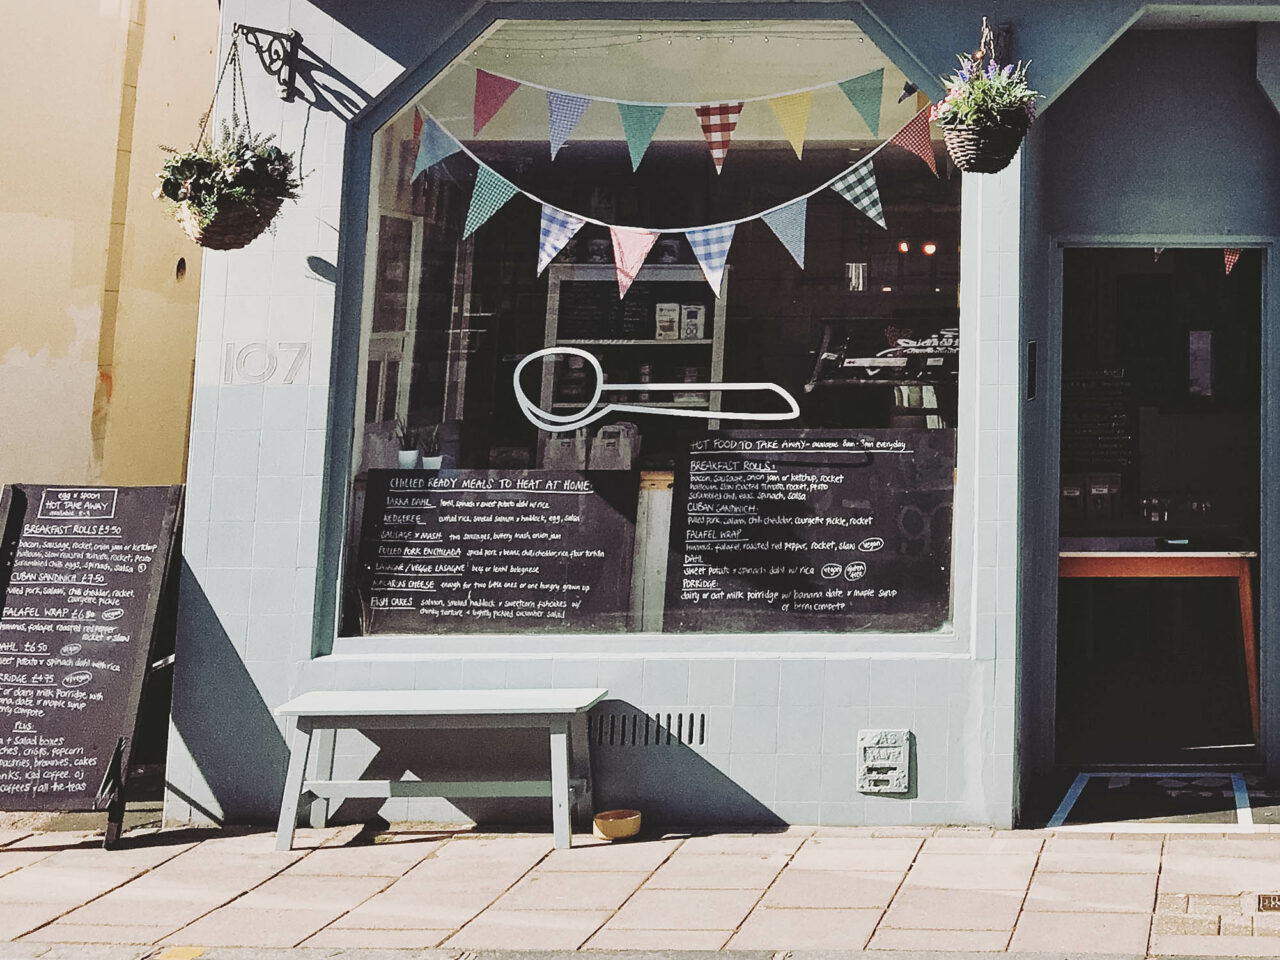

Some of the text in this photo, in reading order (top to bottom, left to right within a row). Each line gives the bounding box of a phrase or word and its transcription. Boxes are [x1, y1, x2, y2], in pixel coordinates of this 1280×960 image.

[224, 342, 308, 384] 107
[714, 438, 737, 449] FOOD
[739, 439, 753, 450] TO
[756, 439, 779, 450] TAKE
[876, 439, 906, 452] everyday
[690, 460, 740, 471] BREAKFAST
[428, 478, 457, 488] READY
[461, 478, 494, 489] MEALS
[499, 479, 512, 489] TO
[516, 479, 544, 489] HEAT
[545, 480, 562, 489] AT
[766, 474, 780, 483] jam
[820, 474, 845, 484] rocket
[810, 483, 829, 492] pesto
[787, 491, 807, 501] salsa
[45, 501, 61, 510] HOT
[84, 501, 108, 511] AWAY
[687, 502, 714, 512] CUBAN
[850, 516, 875, 526] rocket
[24, 524, 97, 535] BREAKFAST ROLLS
[686, 528, 743, 540] FALAFEL WRAP
[420, 532, 442, 540] MASH
[403, 547, 421, 556] PORK
[811, 541, 837, 552] rocket,
[838, 541, 856, 551] slaw
[434, 565, 465, 574] LASAGNE
[408, 580, 435, 589] CHEESE
[681, 591, 700, 604] dairy
[710, 591, 725, 600] oat
[726, 590, 745, 599] milk
[747, 589, 779, 603] porridge
[825, 588, 844, 598] date
[391, 597, 413, 606] CAKES
[3, 606, 69, 617] FALAFEL WRAP
[0, 641, 18, 651] AHL
[39, 735, 65, 745] boxes
[74, 757, 98, 767] cakes
